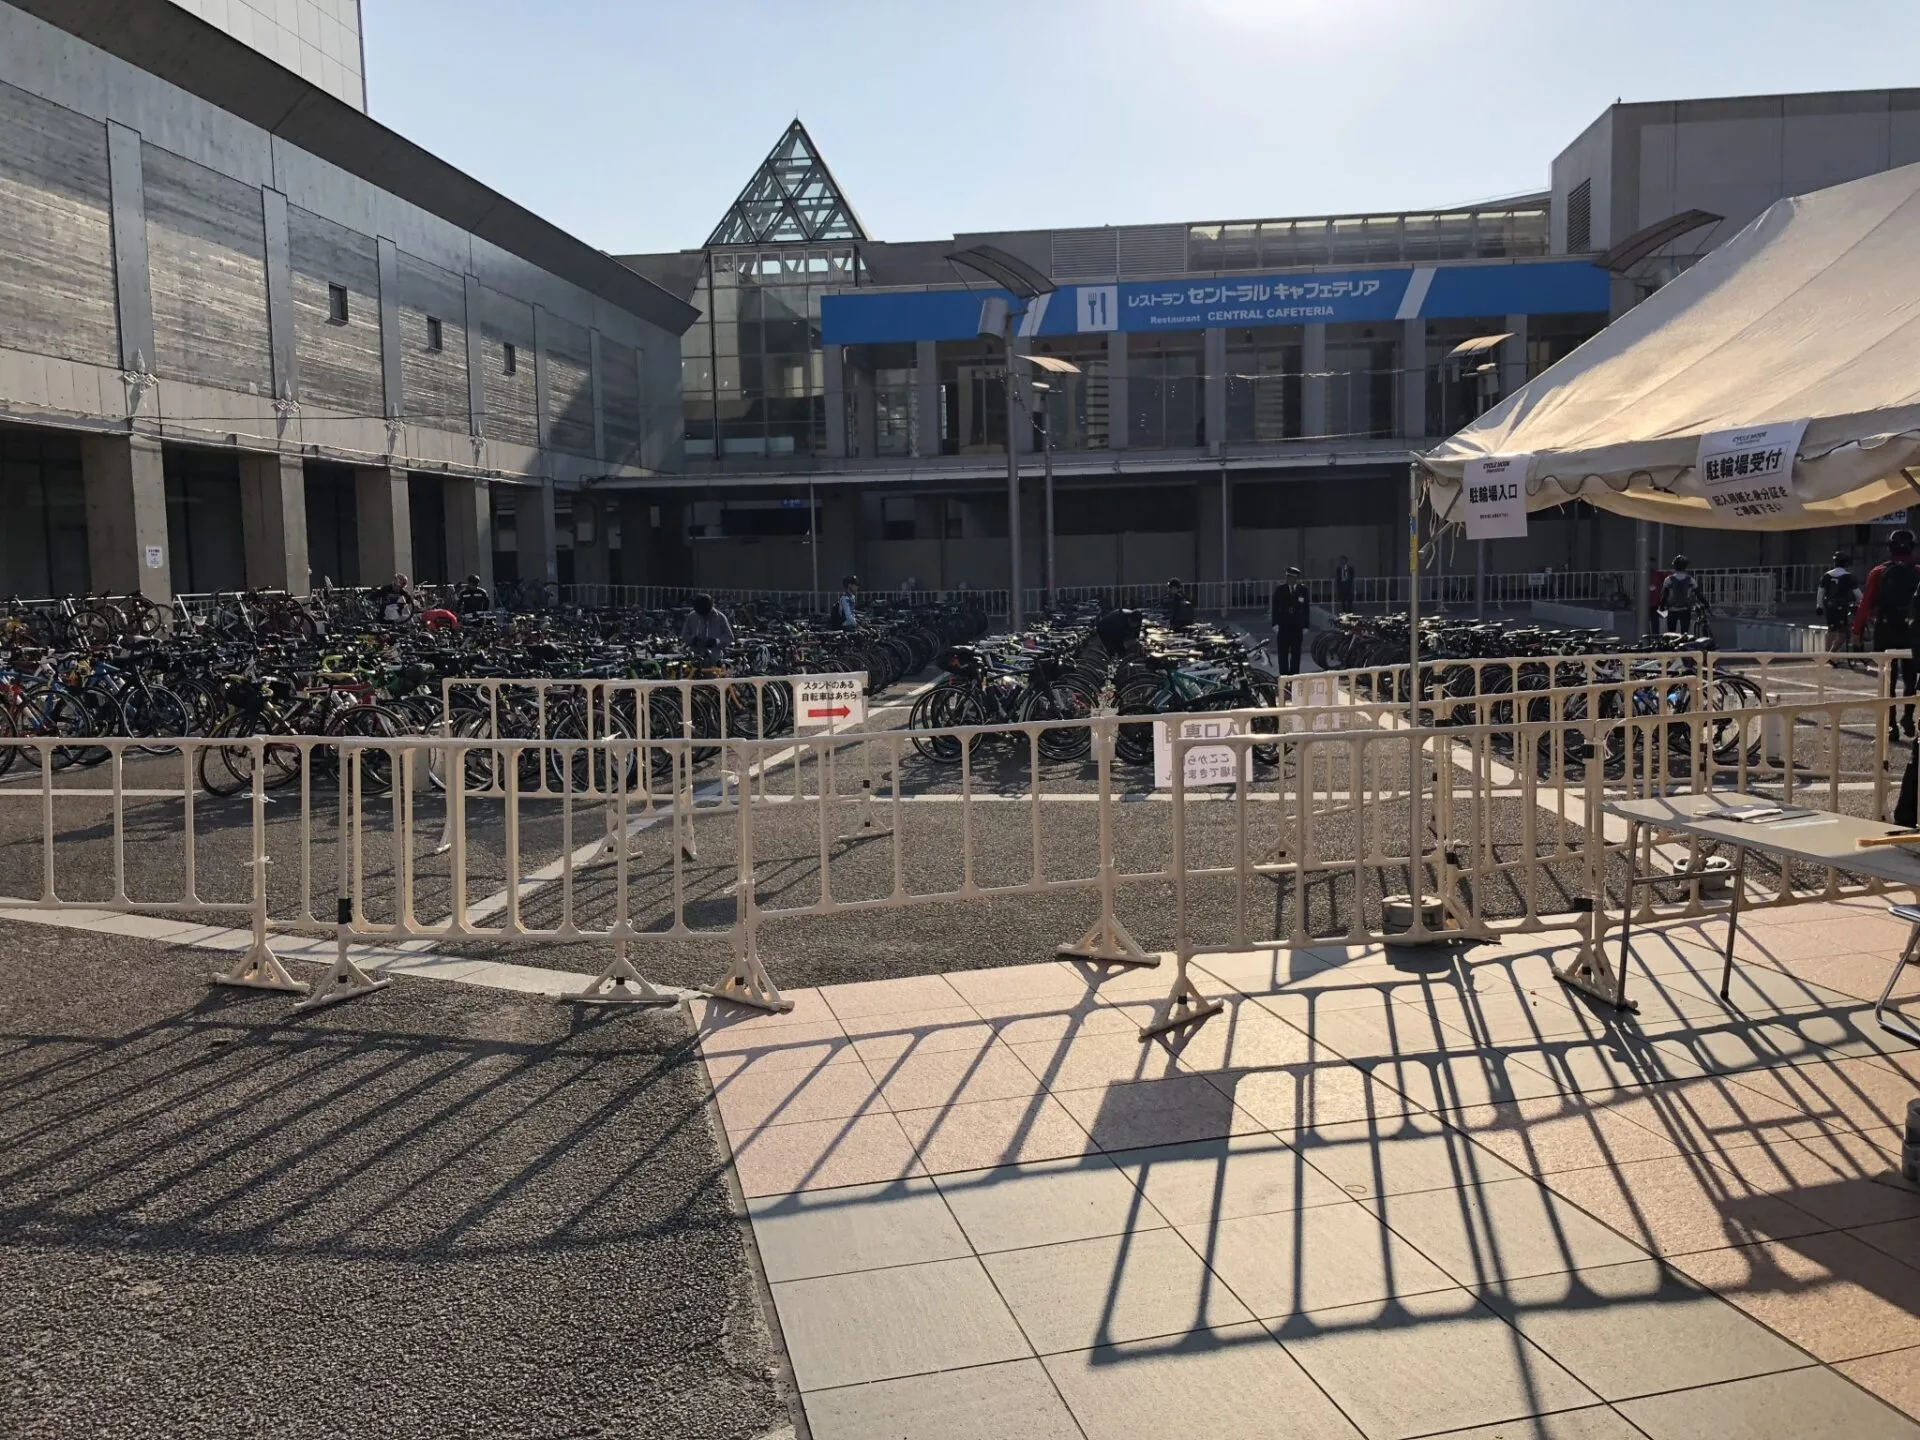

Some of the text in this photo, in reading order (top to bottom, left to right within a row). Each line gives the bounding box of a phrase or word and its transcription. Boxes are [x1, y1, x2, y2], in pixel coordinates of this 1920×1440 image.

[1128, 280, 1380, 307] レストラン セントラル キャフェテリア
[1150, 305, 1335, 324] Restaurant CENTRAL CAFETERIA
[1706, 447, 1783, 481] 駐輪場受付
[1469, 484, 1517, 504] 駐輪場入口
[803, 680, 855, 690] スタンドのある
[801, 691, 857, 702] 自転車はあちら
